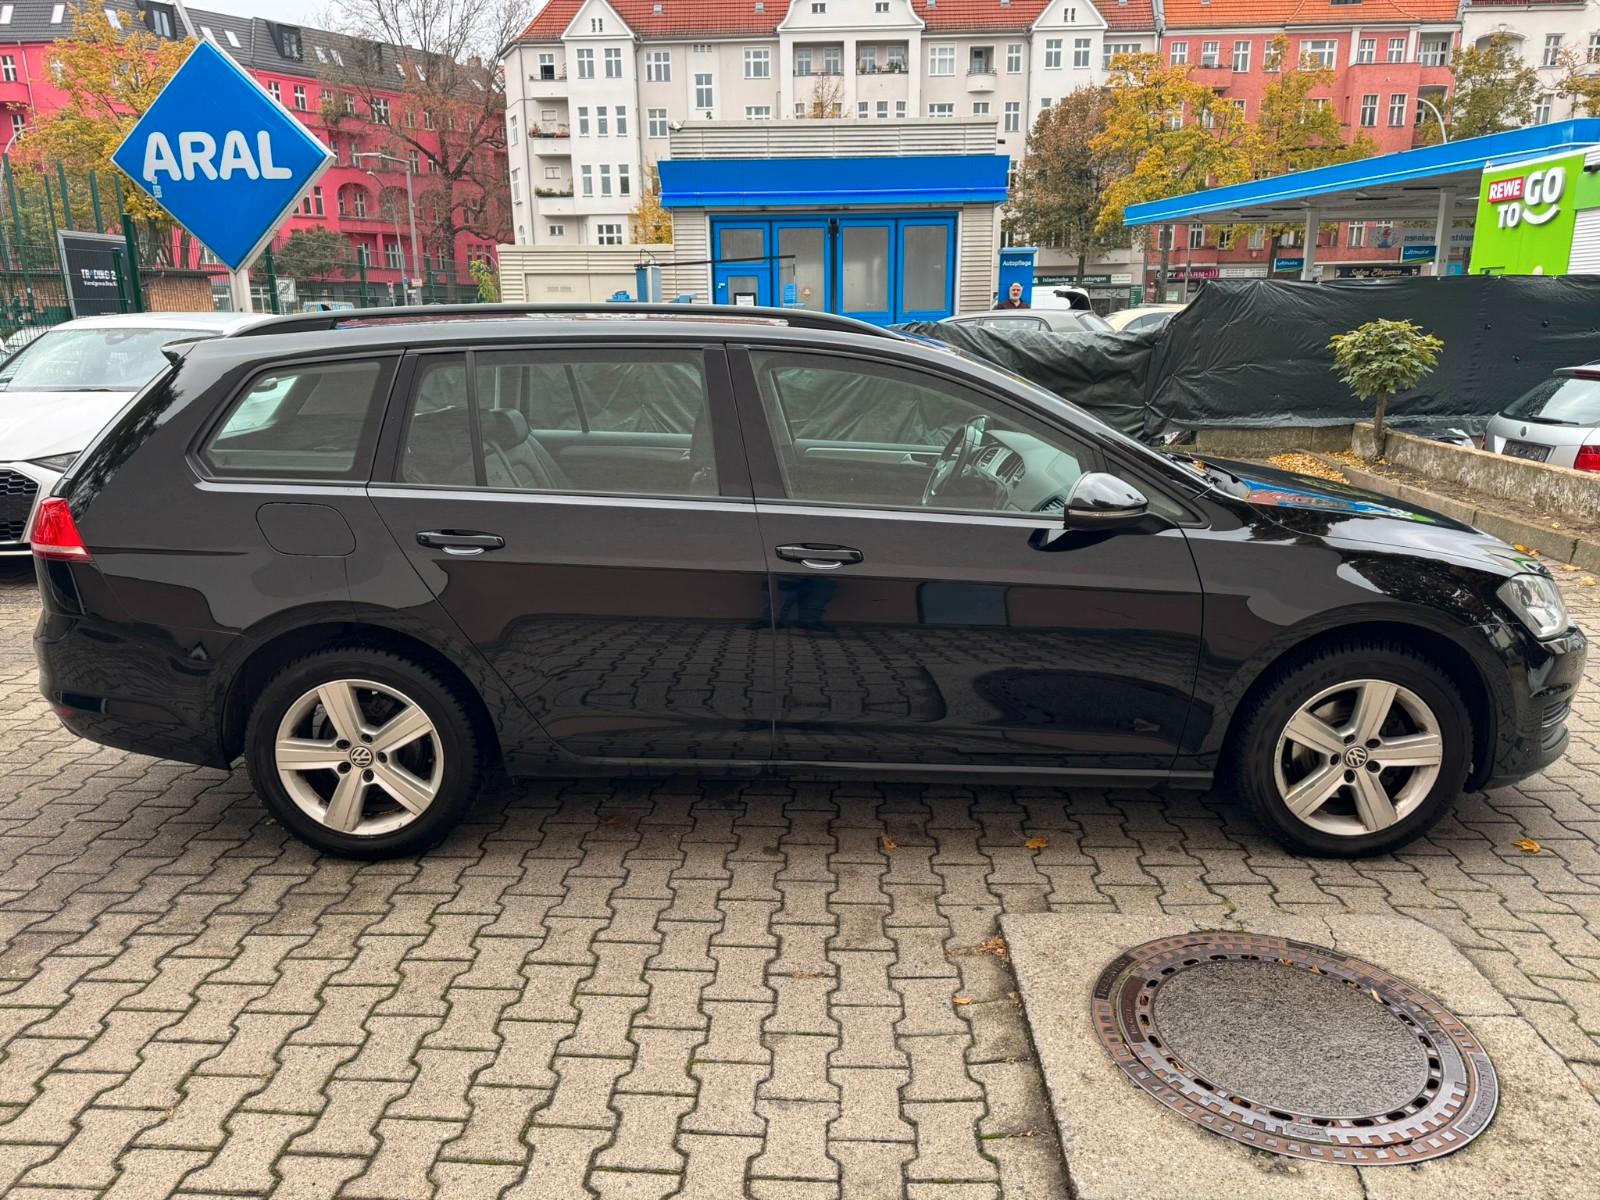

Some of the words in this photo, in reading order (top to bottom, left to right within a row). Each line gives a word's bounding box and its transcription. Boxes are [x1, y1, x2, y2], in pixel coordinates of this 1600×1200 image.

[143, 130, 292, 182] ARAL
[1488, 178, 1522, 200] REWE
[1524, 166, 1566, 206] GO
[1497, 202, 1521, 228] TO
